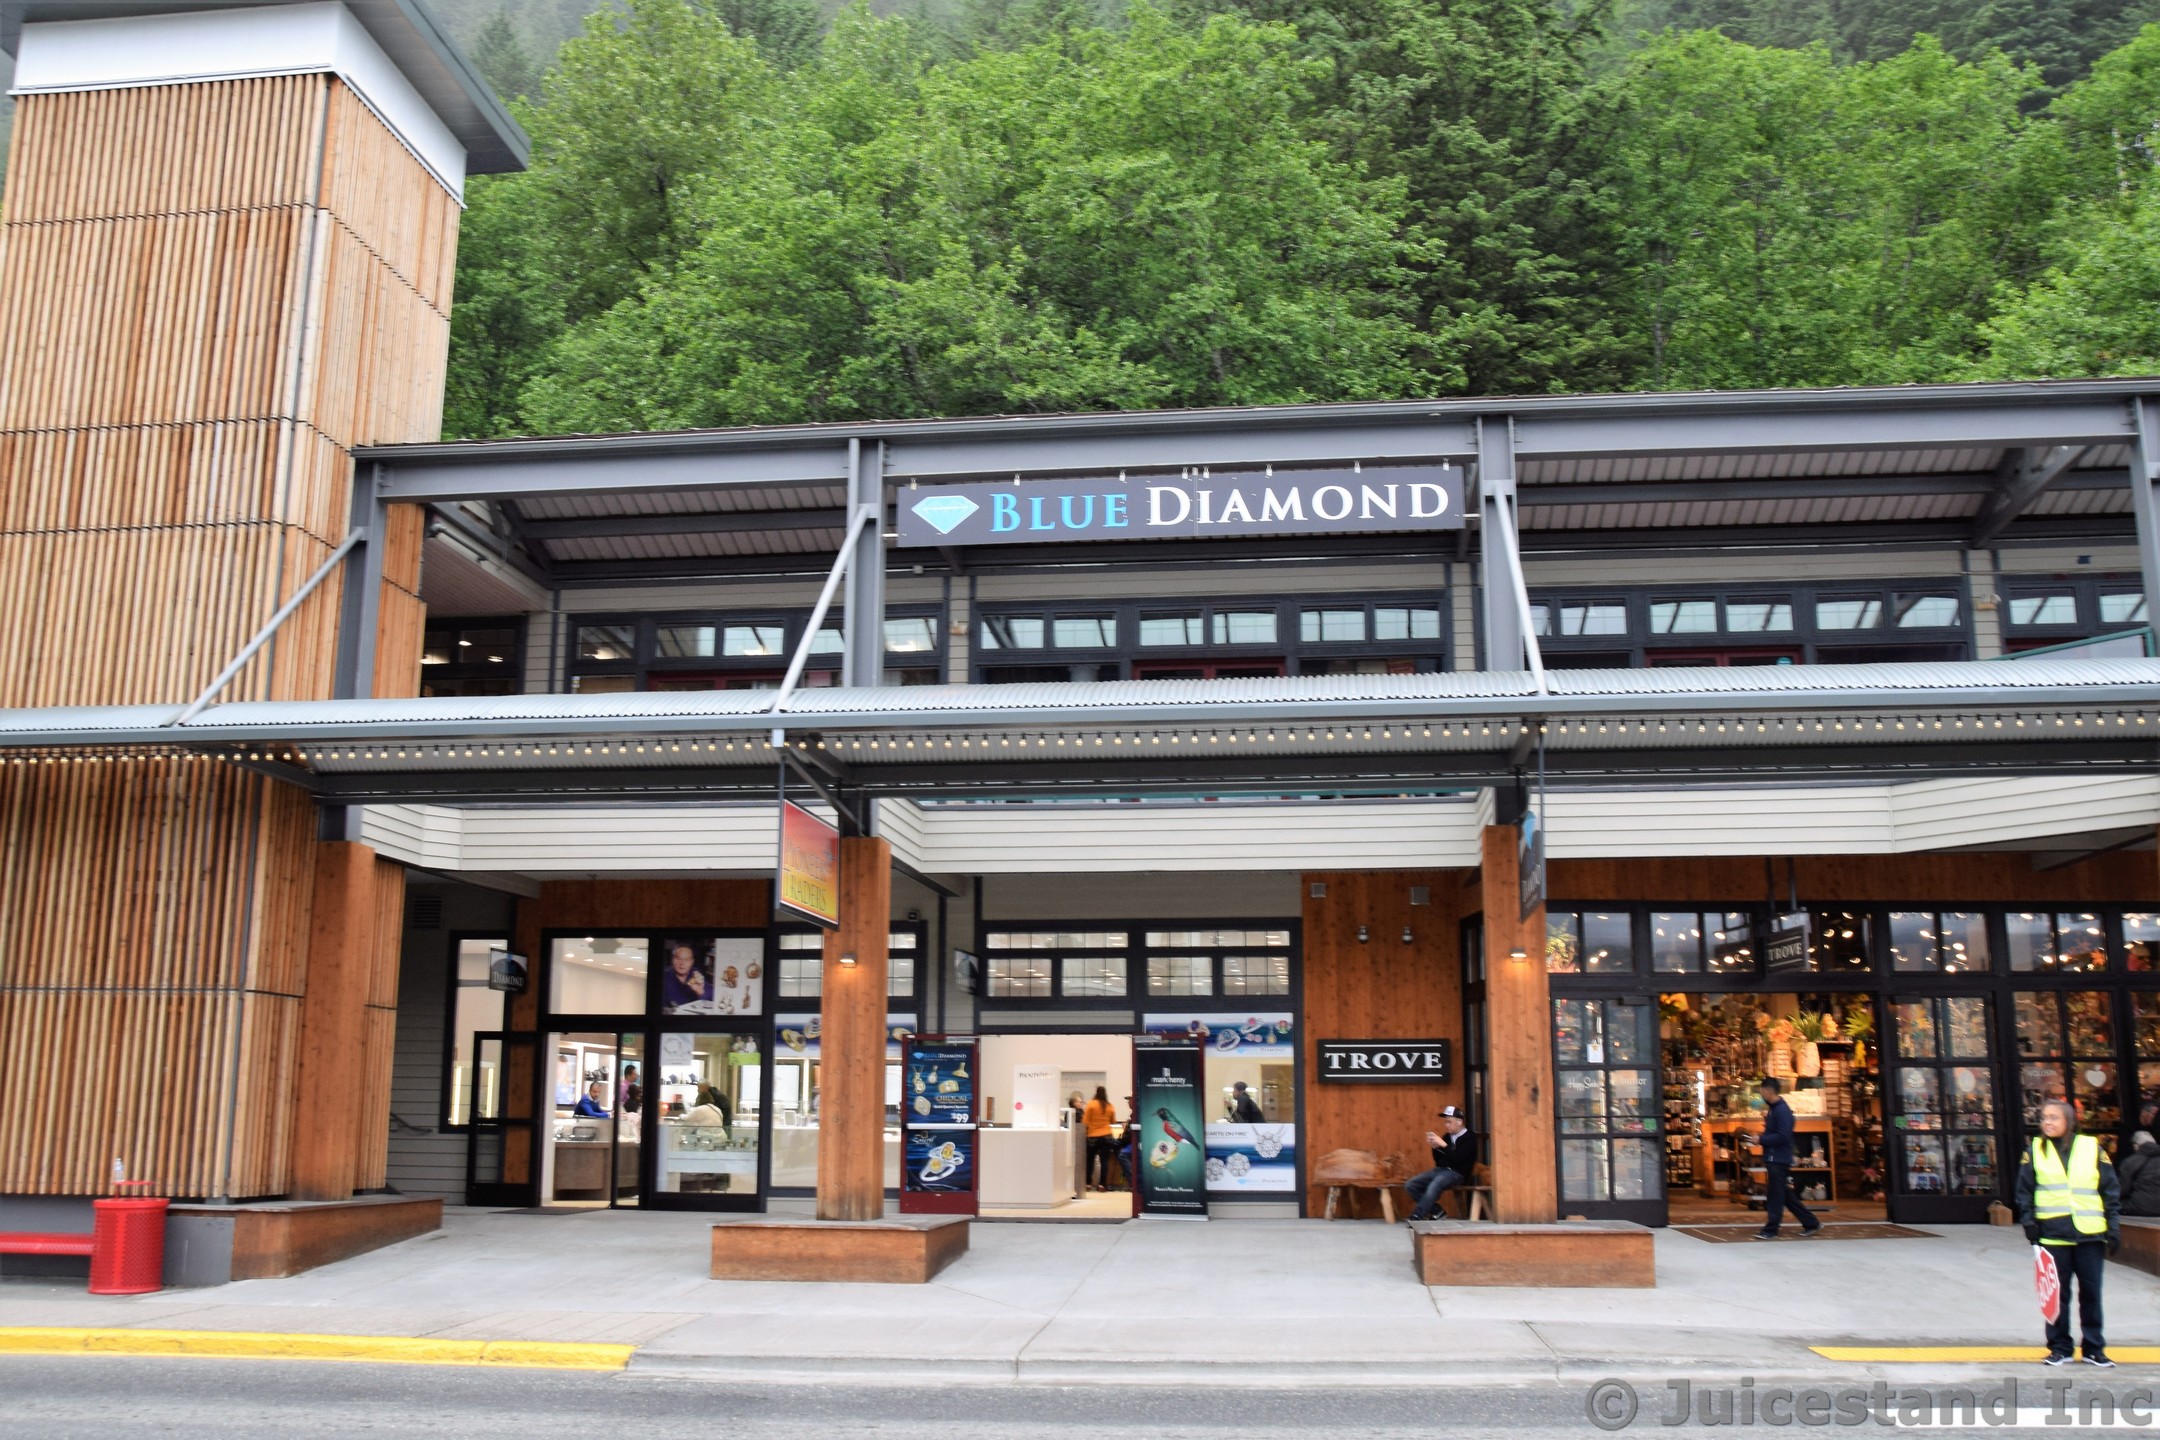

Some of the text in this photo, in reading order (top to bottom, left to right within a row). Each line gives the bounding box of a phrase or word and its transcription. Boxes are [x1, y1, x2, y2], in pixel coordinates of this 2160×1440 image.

[989, 483, 1449, 532] BLUE DIAMOND
[783, 868, 826, 911] TRADERS
[1768, 943, 1802, 960] TROVE
[1324, 1052, 1442, 1069] TROVE
